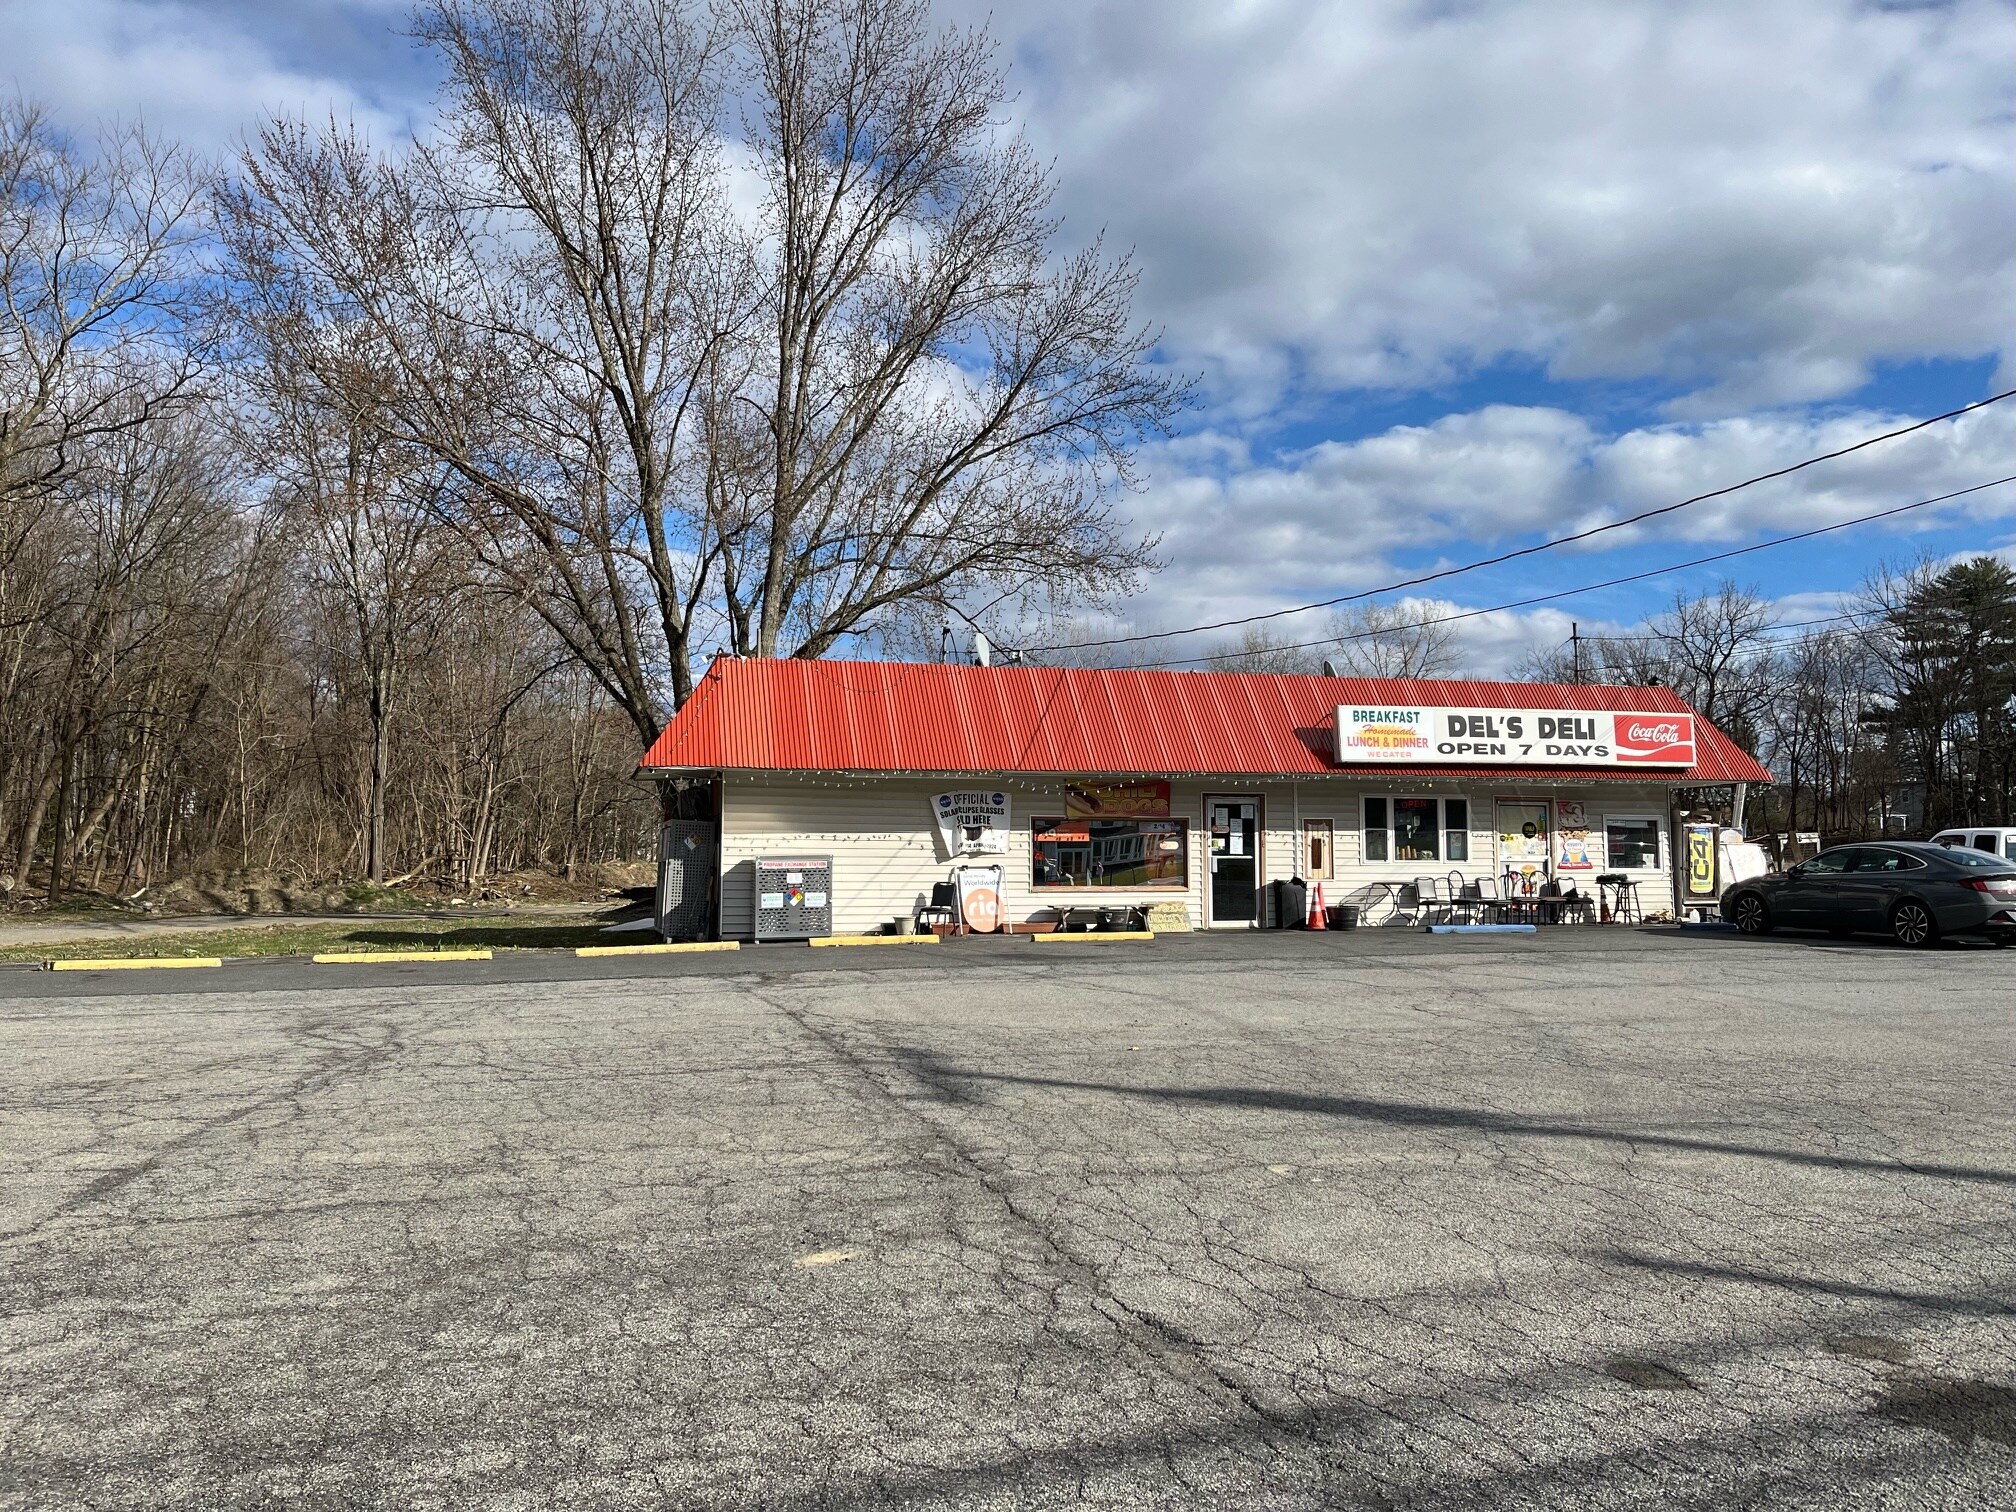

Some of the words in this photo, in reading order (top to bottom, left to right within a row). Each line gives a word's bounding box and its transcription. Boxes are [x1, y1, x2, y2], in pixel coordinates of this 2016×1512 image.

[1352, 710, 1420, 723] BREAKFAST
[1362, 724, 1417, 736] Homemade
[1448, 715, 1523, 739] DEL'S
[1538, 717, 1596, 740] DELI
[1628, 722, 1680, 743] Coca-Cola
[1347, 736, 1380, 747] LUNCH
[1383, 737, 1390, 748] &
[1393, 737, 1429, 748] DINNER
[1437, 742, 1506, 755] OPEN
[1518, 744, 1533, 756] 7
[1546, 744, 1610, 757] DAYS
[953, 793, 990, 805] OFFICIAL
[1401, 800, 1427, 809] OPEN
[1103, 799, 1168, 814] DOGS
[972, 815, 991, 825] HERE
[1693, 837, 1710, 881] C4
[968, 893, 998, 916] ria
